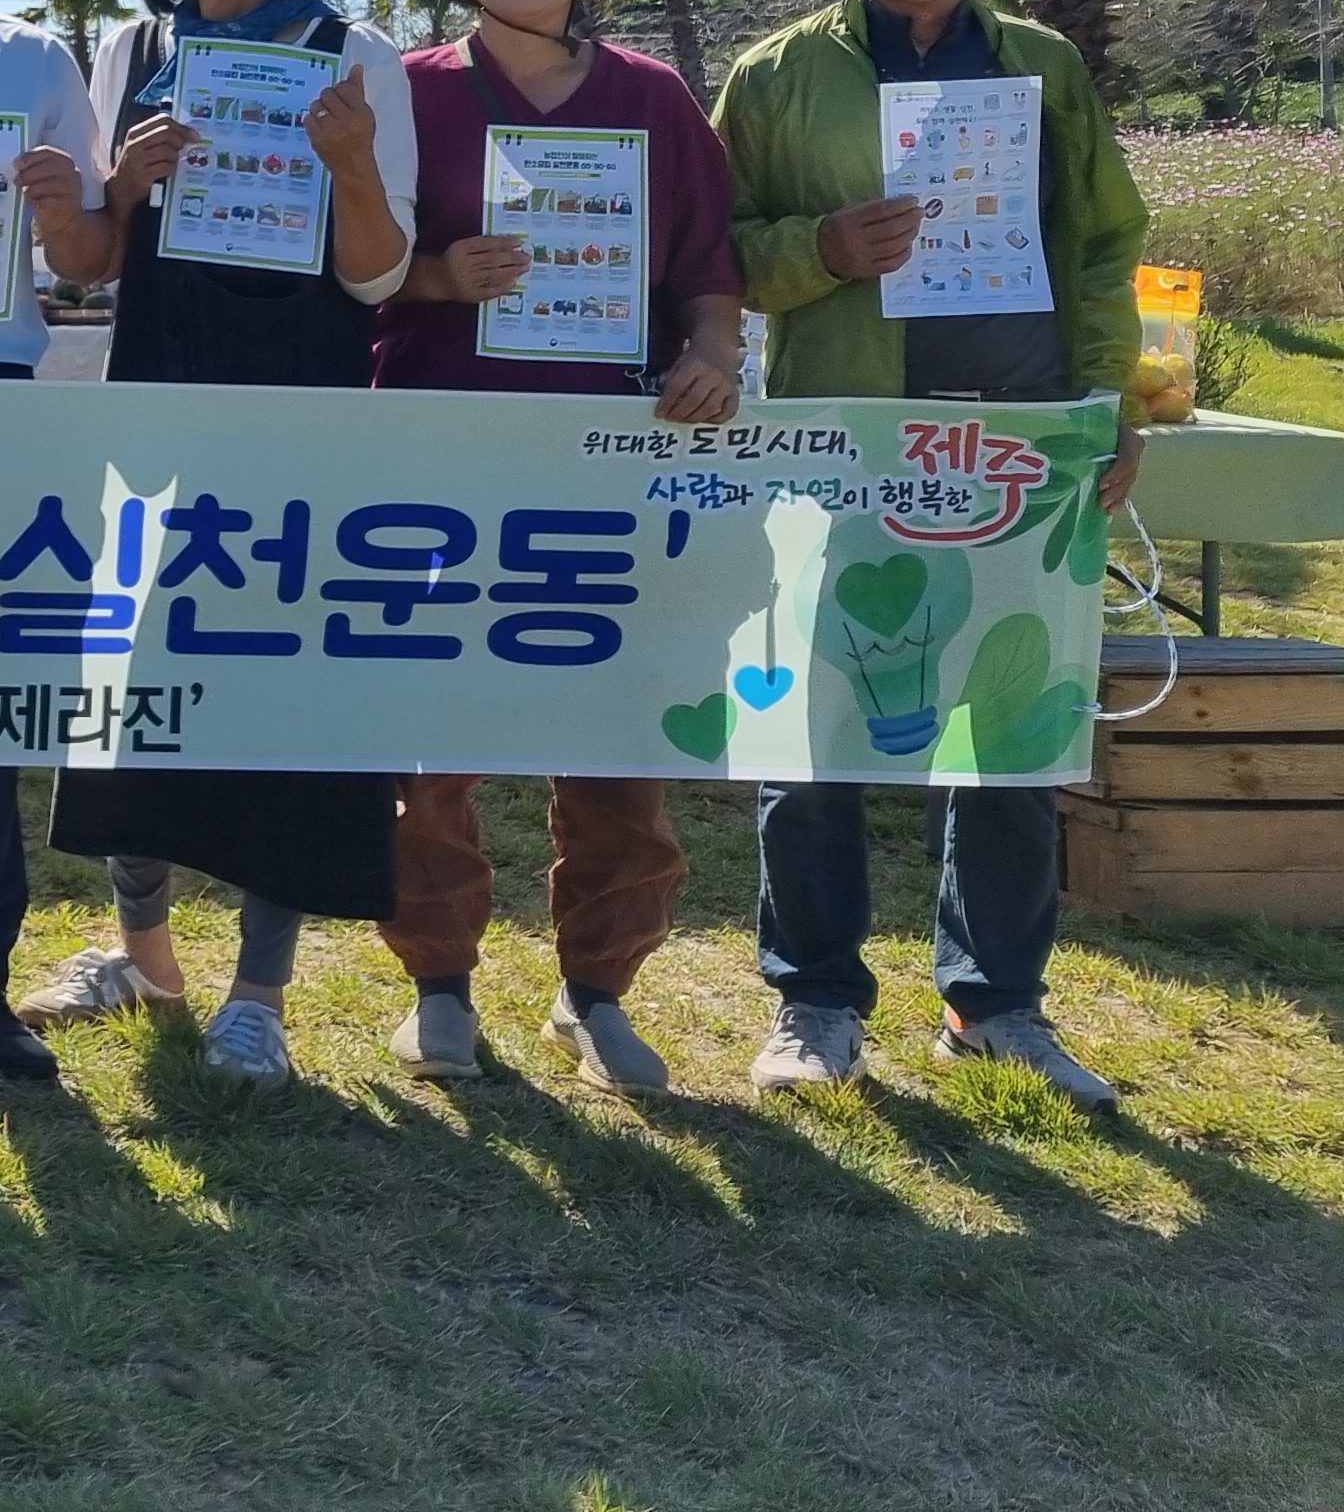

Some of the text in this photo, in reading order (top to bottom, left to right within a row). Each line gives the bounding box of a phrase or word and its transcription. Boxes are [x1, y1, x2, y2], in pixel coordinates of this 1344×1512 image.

[582, 425, 860, 462] 위대한 도민시대,
[646, 471, 972, 517] 사람과 자연이 행복한
[884, 422, 1045, 541] 제주
